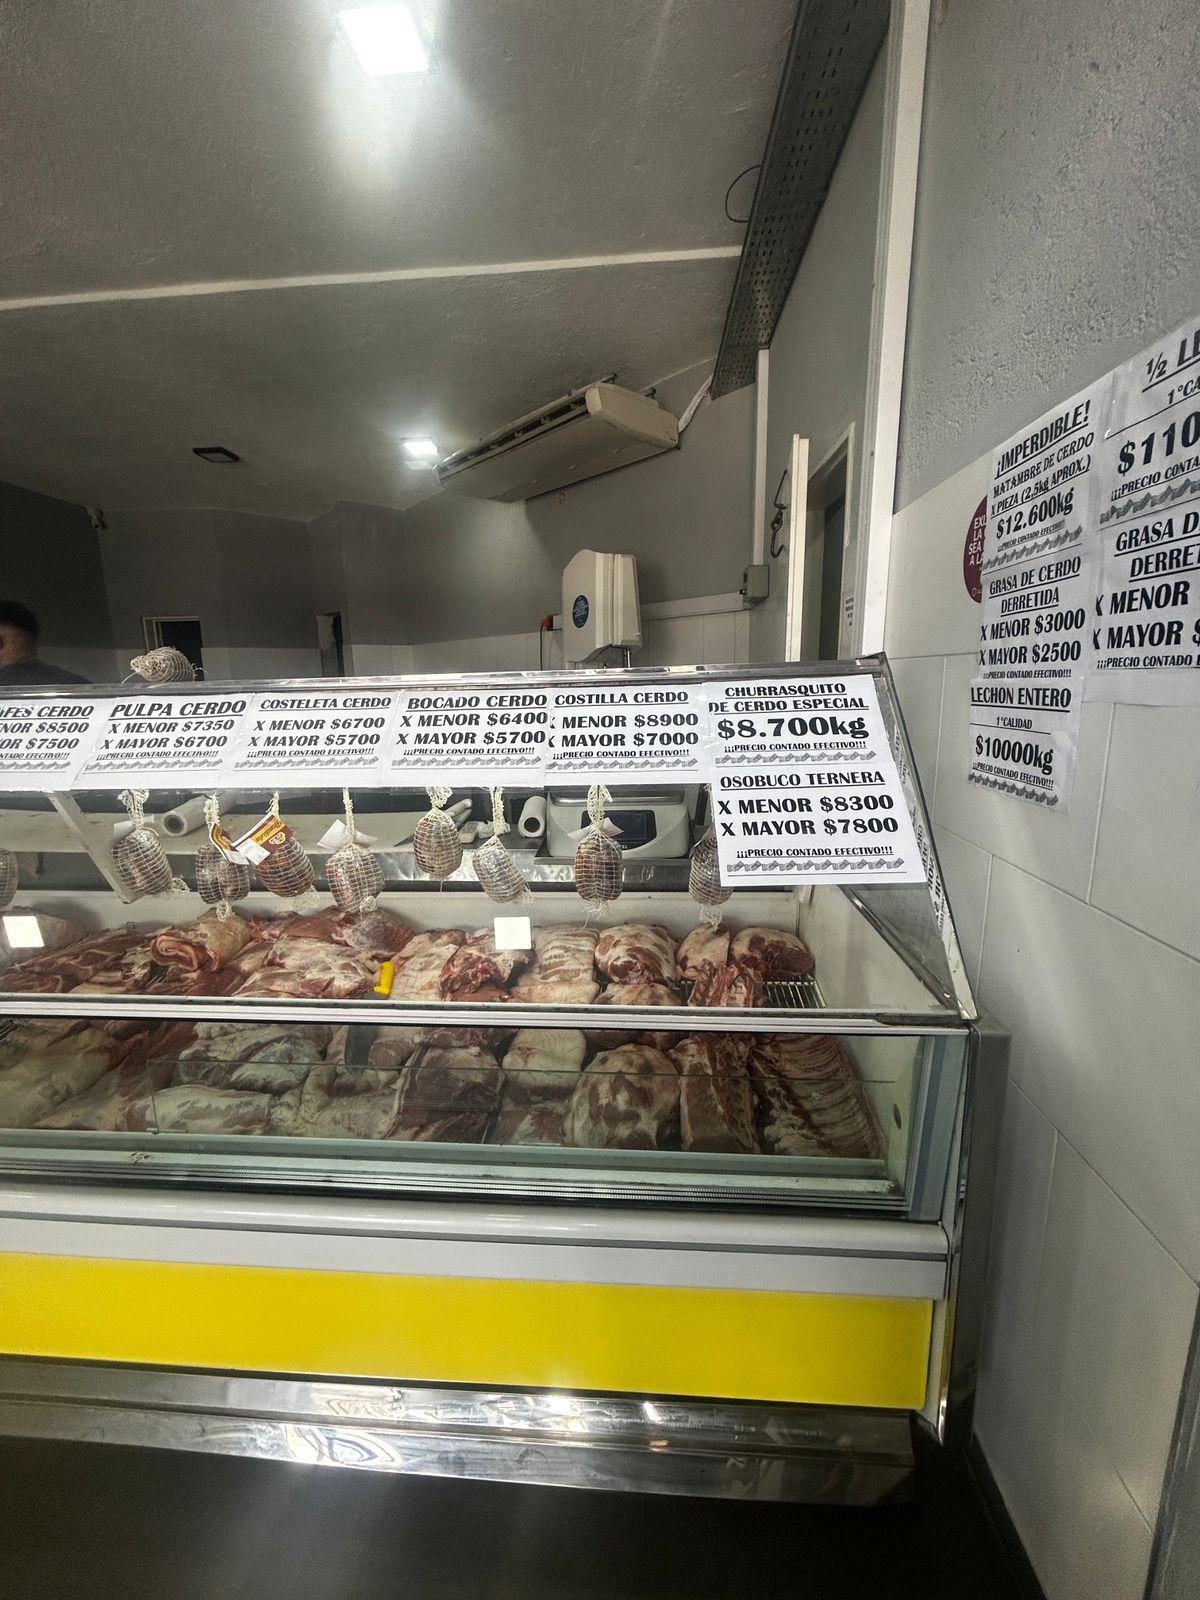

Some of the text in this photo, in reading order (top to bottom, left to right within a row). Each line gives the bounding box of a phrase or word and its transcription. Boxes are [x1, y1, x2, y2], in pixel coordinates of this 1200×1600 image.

[996, 399, 1091, 478] ¡IMPERDIBLE!
[1117, 411, 1200, 476] $110
[993, 432, 1094, 498] MATAMBRE DE CERDO
[997, 493, 1019, 513] PIEZA
[1051, 454, 1091, 487] APROX.)
[996, 487, 1074, 540] $12.600kg
[1116, 511, 1200, 552] GRASA D
[968, 542, 982, 555] SEA
[989, 556, 1081, 595] GRASA DE CERDO
[1001, 587, 1059, 613] DERRETIDA
[1109, 580, 1190, 615] MENOR
[980, 608, 1086, 641] X MENOR $3000
[1107, 620, 1184, 649] MAYOR
[978, 640, 1081, 665] X MAYOR $2500
[1143, 654, 1192, 667] CONTADO
[1006, 670, 1033, 678] CONTADO
[724, 682, 847, 697] CHURRASQUITO
[260, 697, 392, 709] COSTELETA CERDO
[407, 694, 548, 709] BOCADO CERDO
[554, 691, 689, 705] COSTILLA CERDO
[708, 697, 868, 713] DE CERDO ESPECIAL
[970, 687, 1072, 708] LECHON ENTERO
[37, 705, 95, 717] CERDO
[110, 700, 247, 717] PULPA CERDO
[108, 719, 235, 734] X MENOR $7350
[253, 717, 386, 731] X MENOR $6700
[400, 712, 548, 727] X MENOR $6400
[562, 715, 627, 729] MENOR
[634, 713, 699, 728] $8900
[36, 722, 90, 733] $8500
[717, 716, 870, 739] $8.700kg
[26, 738, 80, 750] $7500
[100, 735, 228, 750] X MAYOR $6700
[248, 733, 381, 747] X MAYOR $5700
[396, 730, 546, 745] X MAYOR $5700
[561, 734, 626, 747] MAYOR
[633, 732, 699, 747] $7000
[288, 749, 326, 757] CONTADO
[769, 743, 811, 751] CONTADO
[813, 741, 867, 750] EFECTIVO!!!
[596, 750, 636, 758] CONTADO
[975, 734, 1054, 775] $10000kg
[720, 771, 886, 788] OSOBUCO TERNERA
[994, 765, 1019, 779] CONTADO
[718, 795, 894, 815] X MENOR $8300
[721, 817, 899, 837] X MAYOR $7800
[736, 846, 893, 858] ¡¡¡PRECIO CONTADO EFECTIVO!!!
